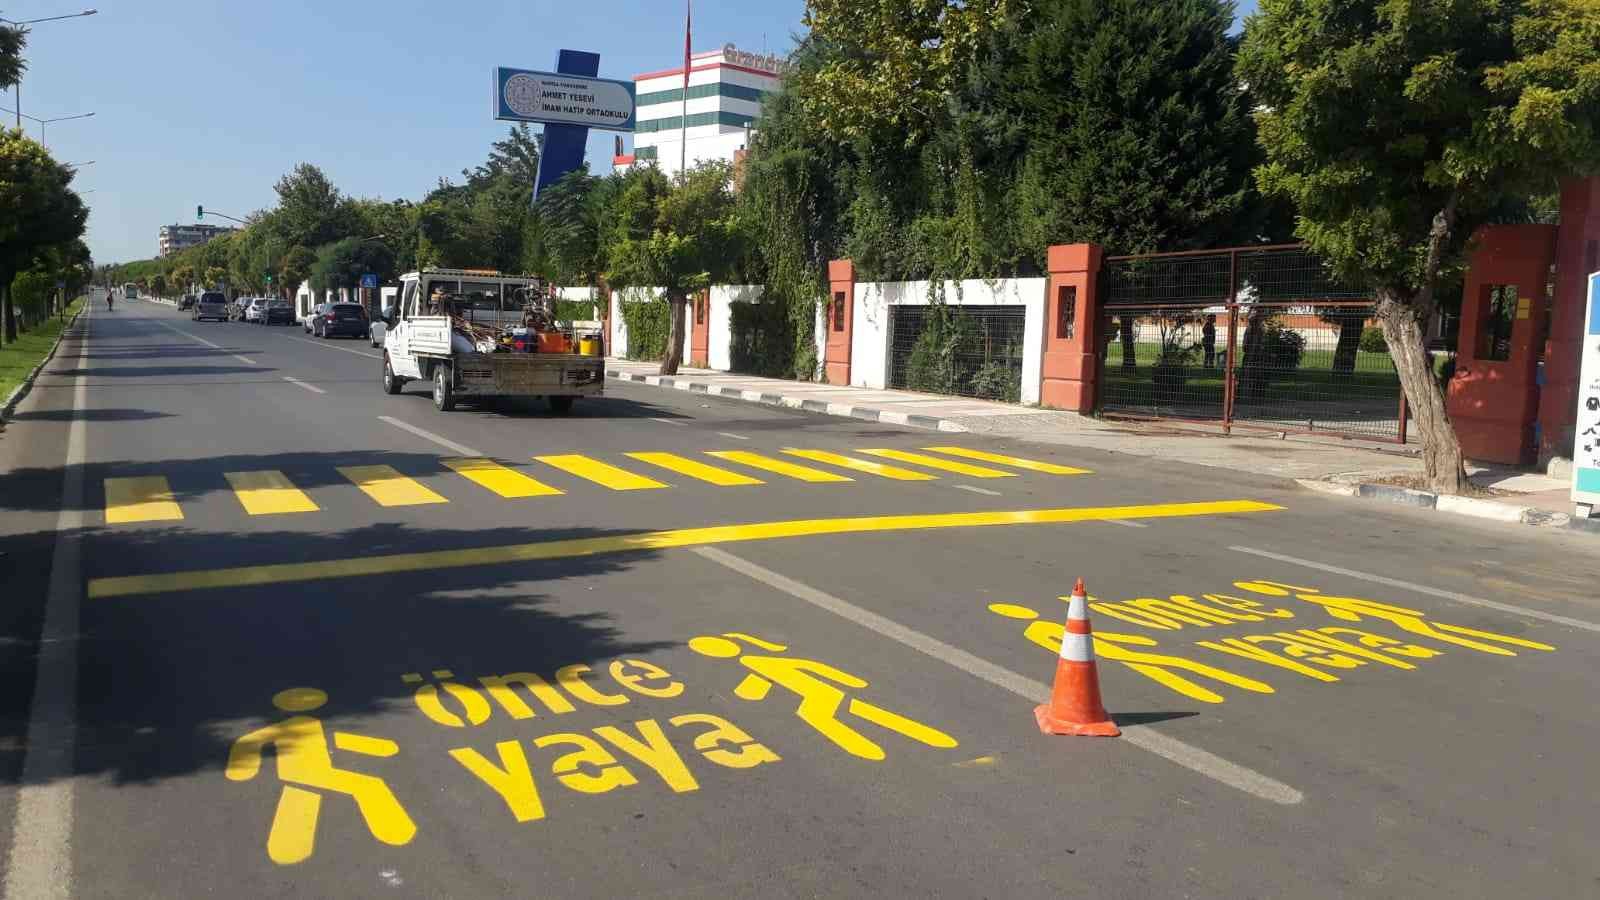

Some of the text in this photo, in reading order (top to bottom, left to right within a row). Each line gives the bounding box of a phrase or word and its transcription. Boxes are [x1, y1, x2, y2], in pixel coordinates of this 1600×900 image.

[541, 90, 567, 101] AHMET
[585, 107, 628, 119] ORTAOKULU
[1193, 627, 1446, 682] yaya
[401, 659, 684, 727] önce
[448, 714, 783, 823] yaya
